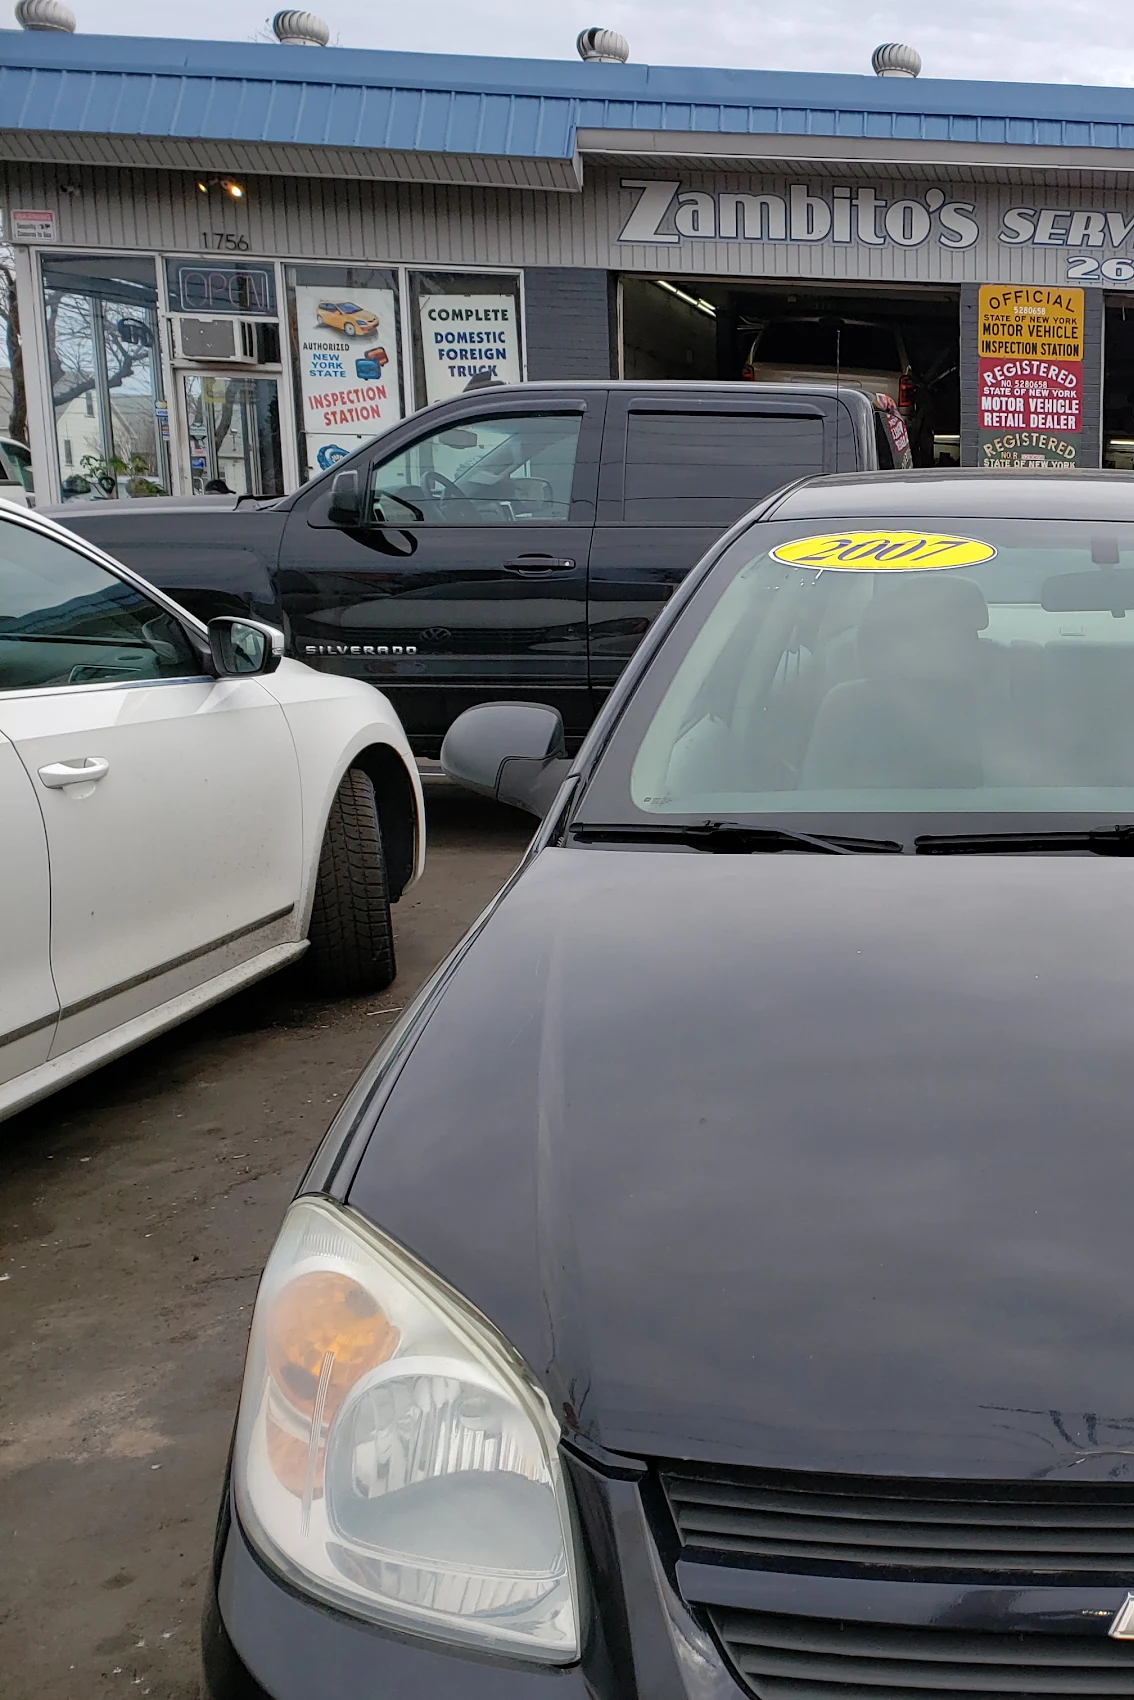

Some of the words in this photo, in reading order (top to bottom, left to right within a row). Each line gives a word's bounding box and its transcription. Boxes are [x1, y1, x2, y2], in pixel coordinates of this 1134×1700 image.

[617, 178, 980, 249] Zambito's
[202, 232, 249, 251] 1756
[184, 272, 265, 310] OPEN
[989, 289, 1075, 313] OFFICIAL
[428, 308, 509, 321] COMPLETE
[1013, 306, 1046, 315] 5280658
[983, 314, 1011, 322] STATE
[1014, 315, 1026, 323] OF
[1029, 316, 1050, 324] NEW
[1053, 317, 1077, 325] YORK
[434, 331, 506, 344] DOMESTIC
[983, 323, 1023, 337] MOTOR
[1028, 324, 1078, 339] VEHICLE
[303, 342, 350, 351] AUTHORIZED
[438, 348, 507, 360] FOREIGN
[981, 340, 1037, 355] INSPECTION
[1040, 342, 1079, 357] STATION
[311, 361, 343, 369] YORK
[313, 353, 340, 361] NEW
[983, 360, 1077, 388] REGISTERED
[1014, 380, 1048, 388] 5280658
[308, 385, 387, 410] INSPECTION
[983, 387, 1011, 396] STATE
[1014, 388, 1026, 396] OF
[1029, 388, 1049, 397] NEW
[1052, 389, 1077, 398] YORK
[981, 396, 1024, 412] MOTOR
[1029, 398, 1079, 414] VEHICLE
[324, 404, 381, 426] STATION
[984, 412, 1026, 428] RETAIL
[1030, 414, 1076, 429] DEALER
[983, 432, 1076, 459] REGISTERED
[983, 458, 1011, 468] STATE
[1014, 459, 1026, 468] OF
[1029, 460, 1049, 468] NEW
[792, 538, 970, 562] 2007
[305, 645, 417, 655] SILVERADO
